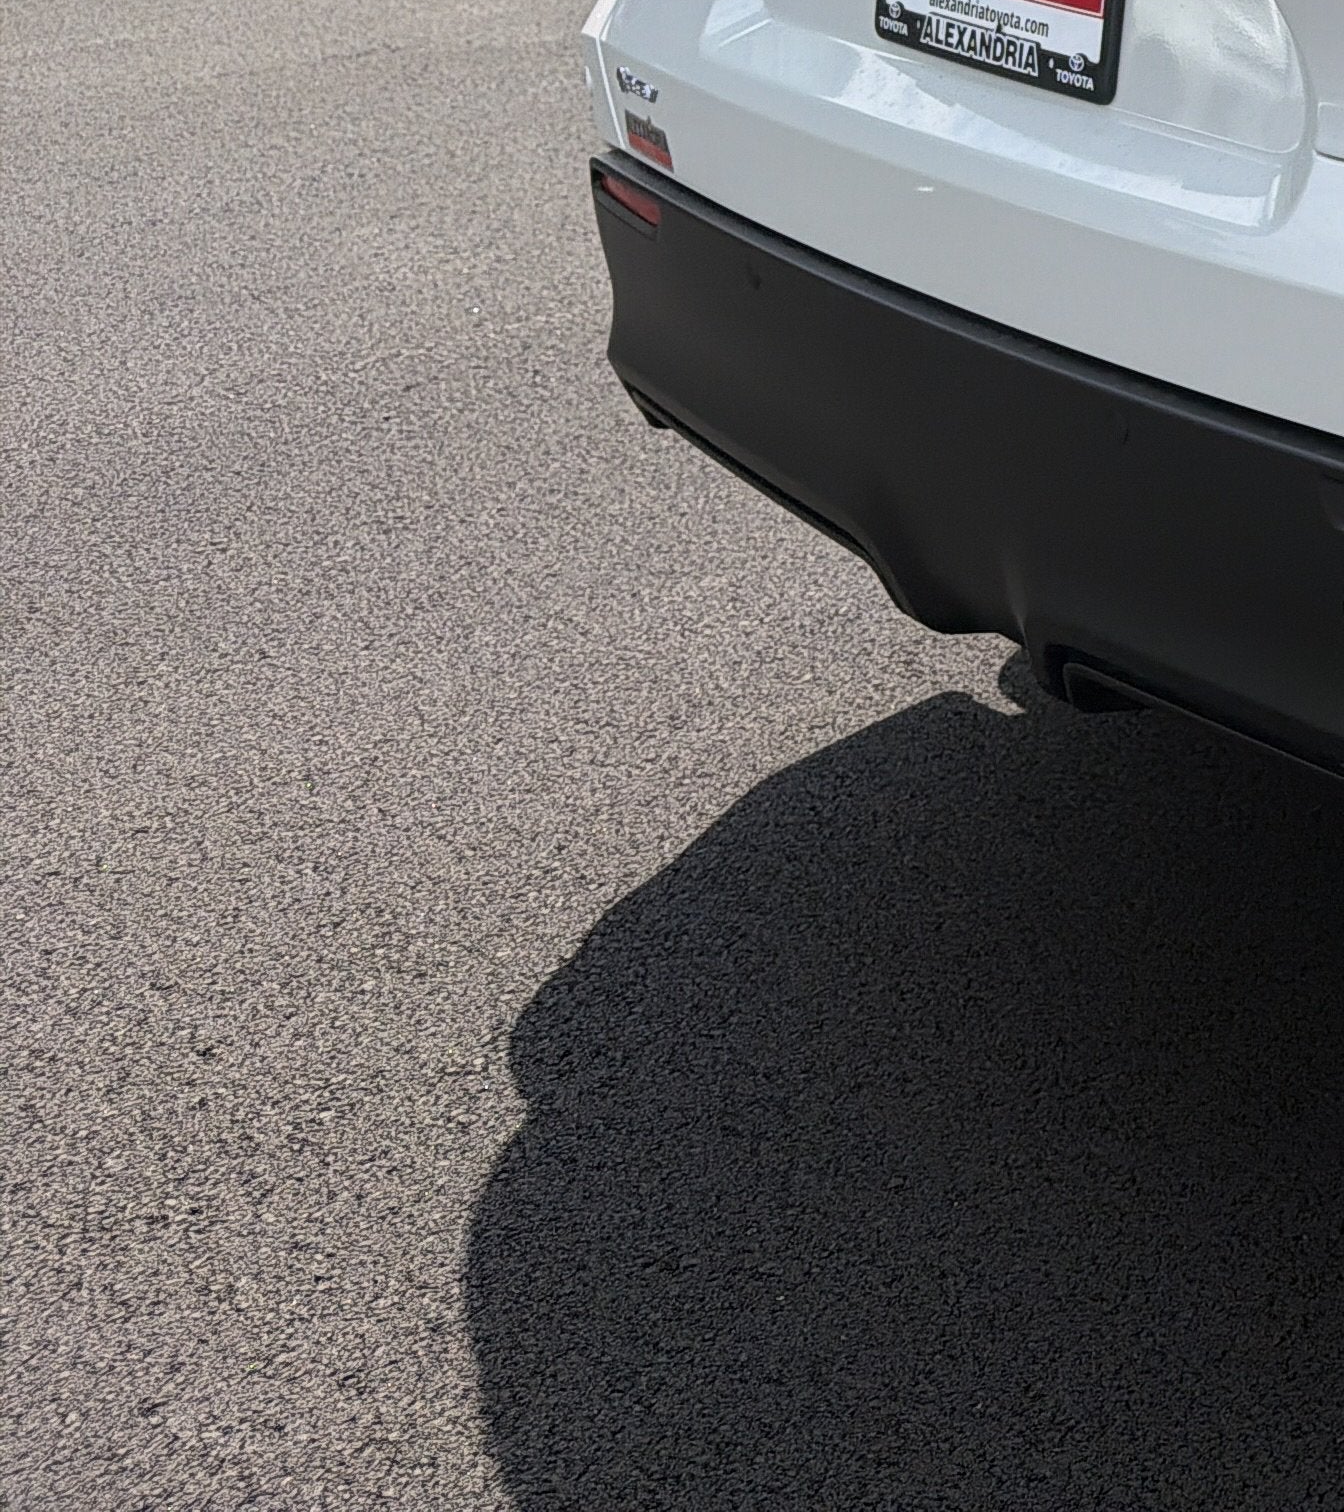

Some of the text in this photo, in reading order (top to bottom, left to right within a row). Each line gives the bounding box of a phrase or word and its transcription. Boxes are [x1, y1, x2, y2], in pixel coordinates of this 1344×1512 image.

[879, 15, 909, 37] TOYOTA
[921, 13, 1039, 77] ALEXANDRIA
[1055, 68, 1095, 92] TOYOTA
